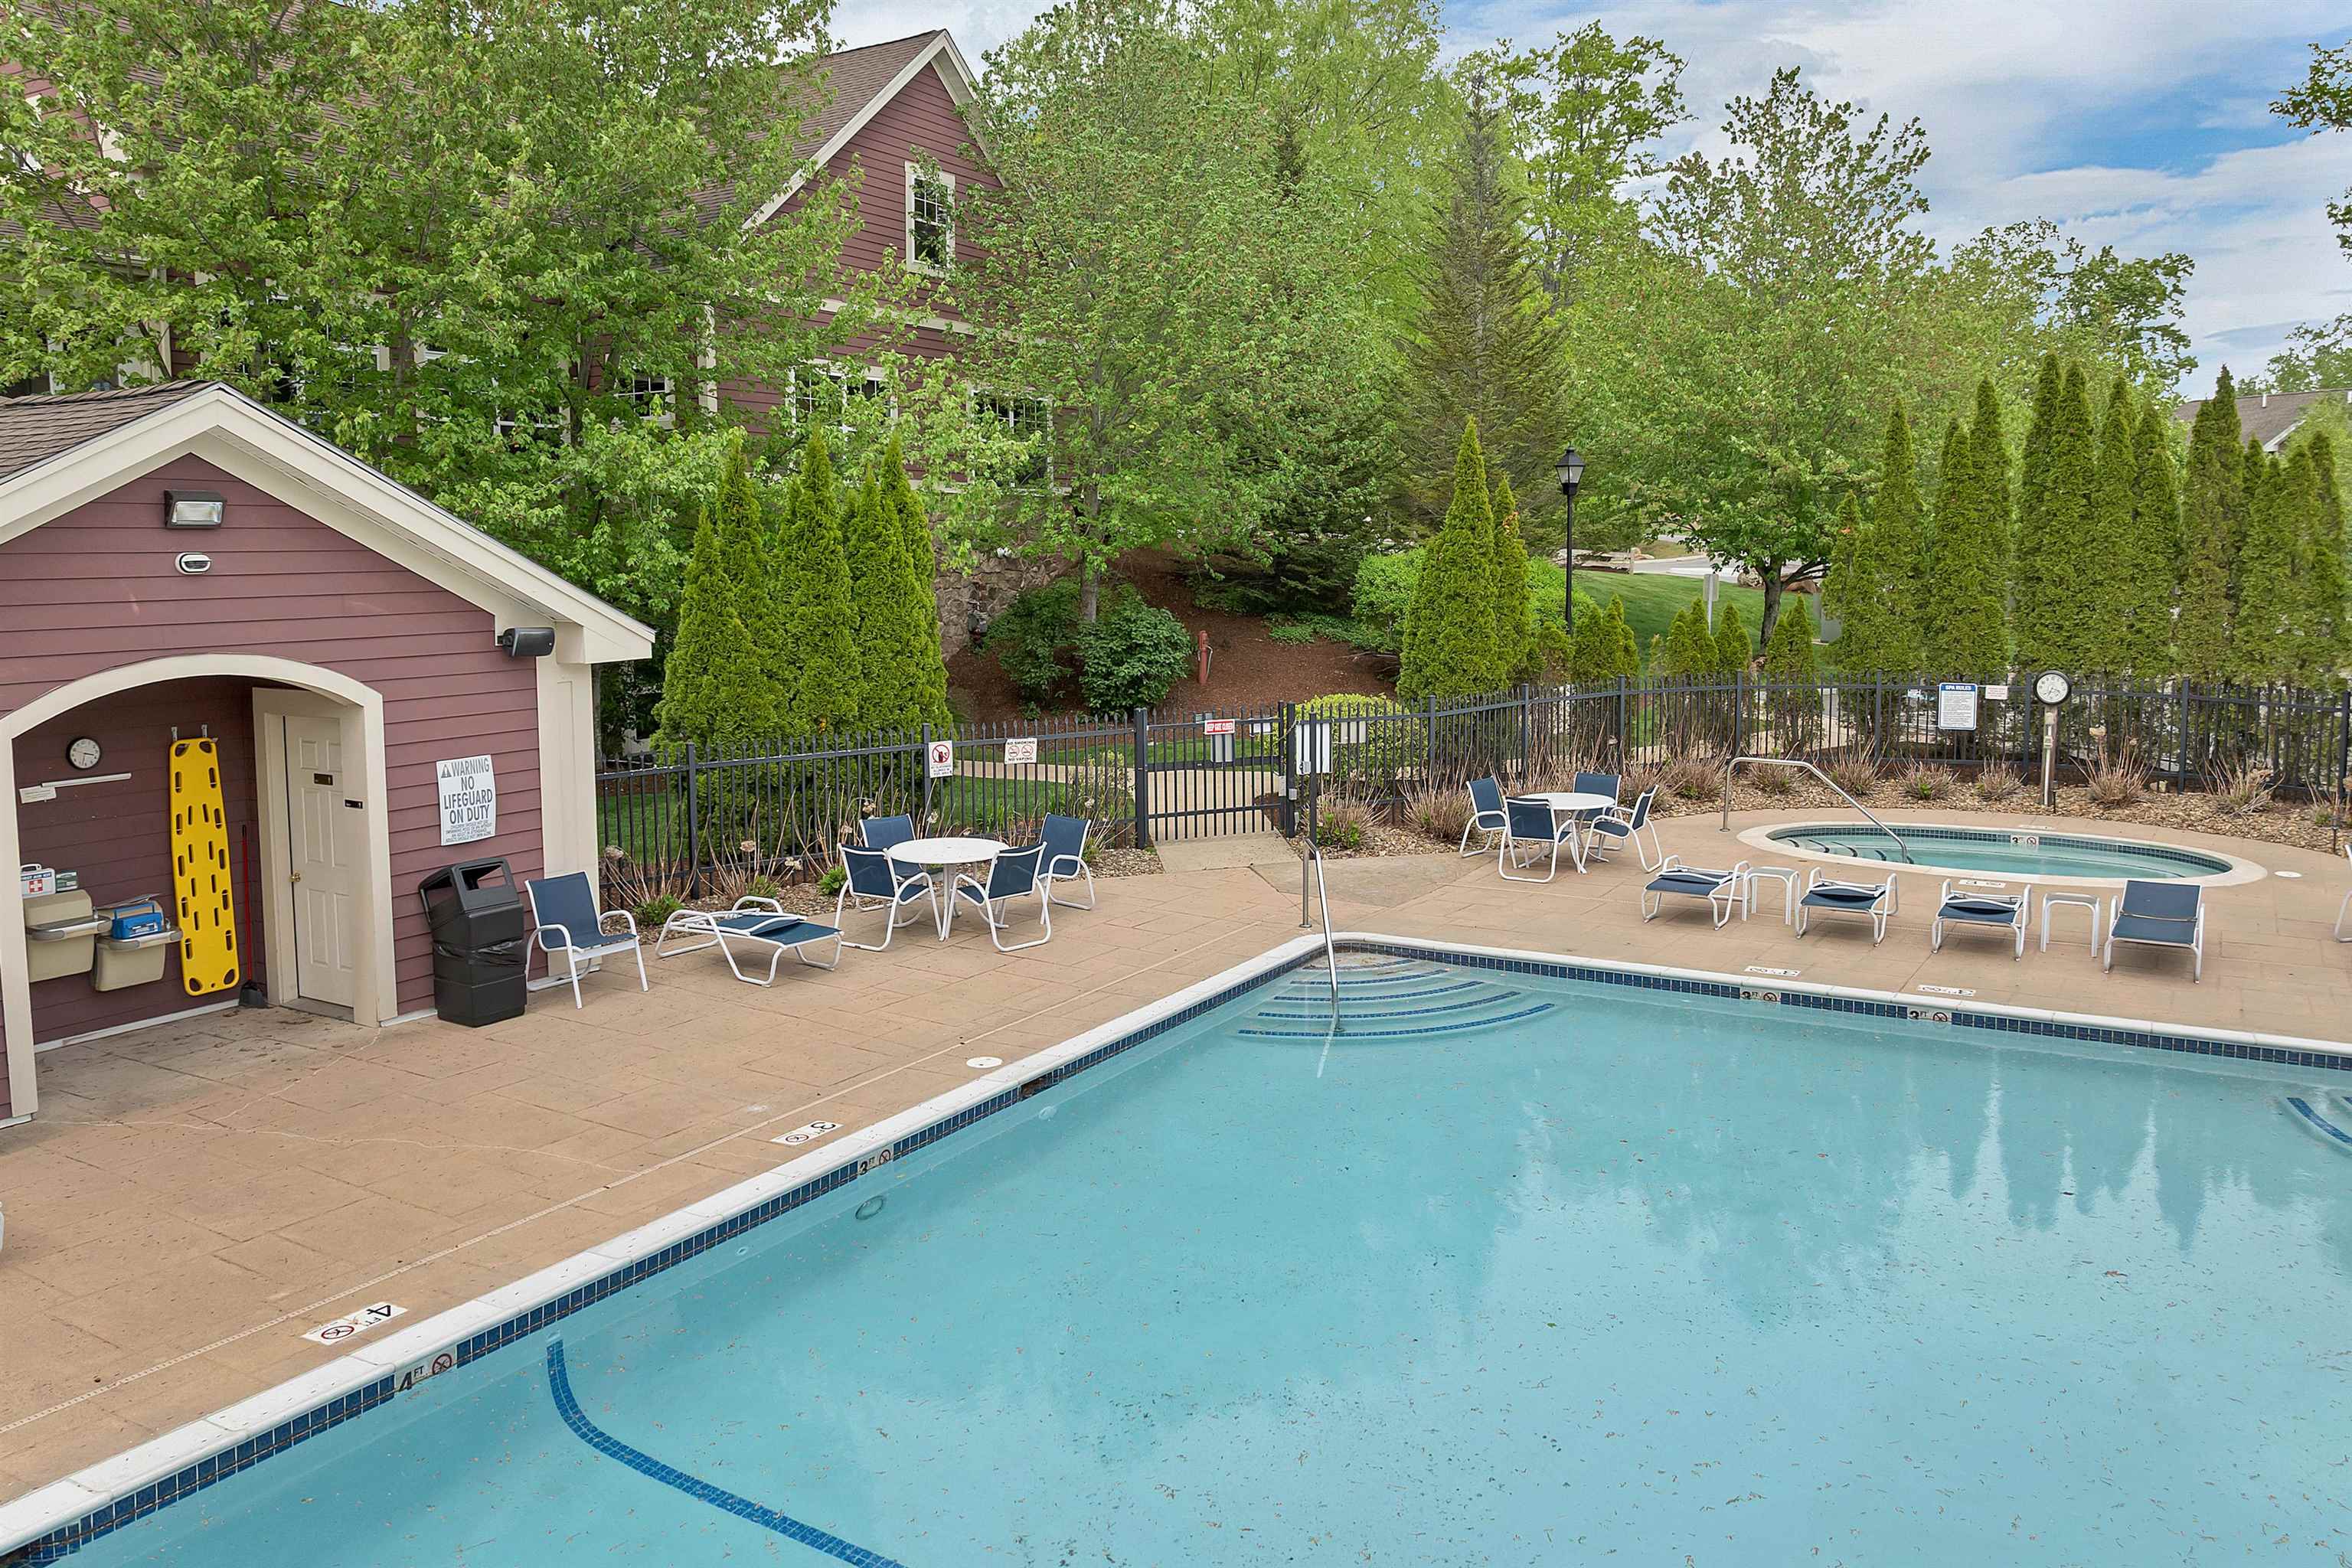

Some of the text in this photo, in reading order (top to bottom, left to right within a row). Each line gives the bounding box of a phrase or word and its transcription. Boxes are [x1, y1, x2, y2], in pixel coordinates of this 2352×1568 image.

[451, 758, 490, 777] WARNING
[461, 776, 475, 791] NO
[444, 789, 493, 810] LIFEGUARD
[449, 805, 490, 825] ON DUTY
[811, 1122, 836, 1130] 3
[366, 1305, 391, 1317] 4
